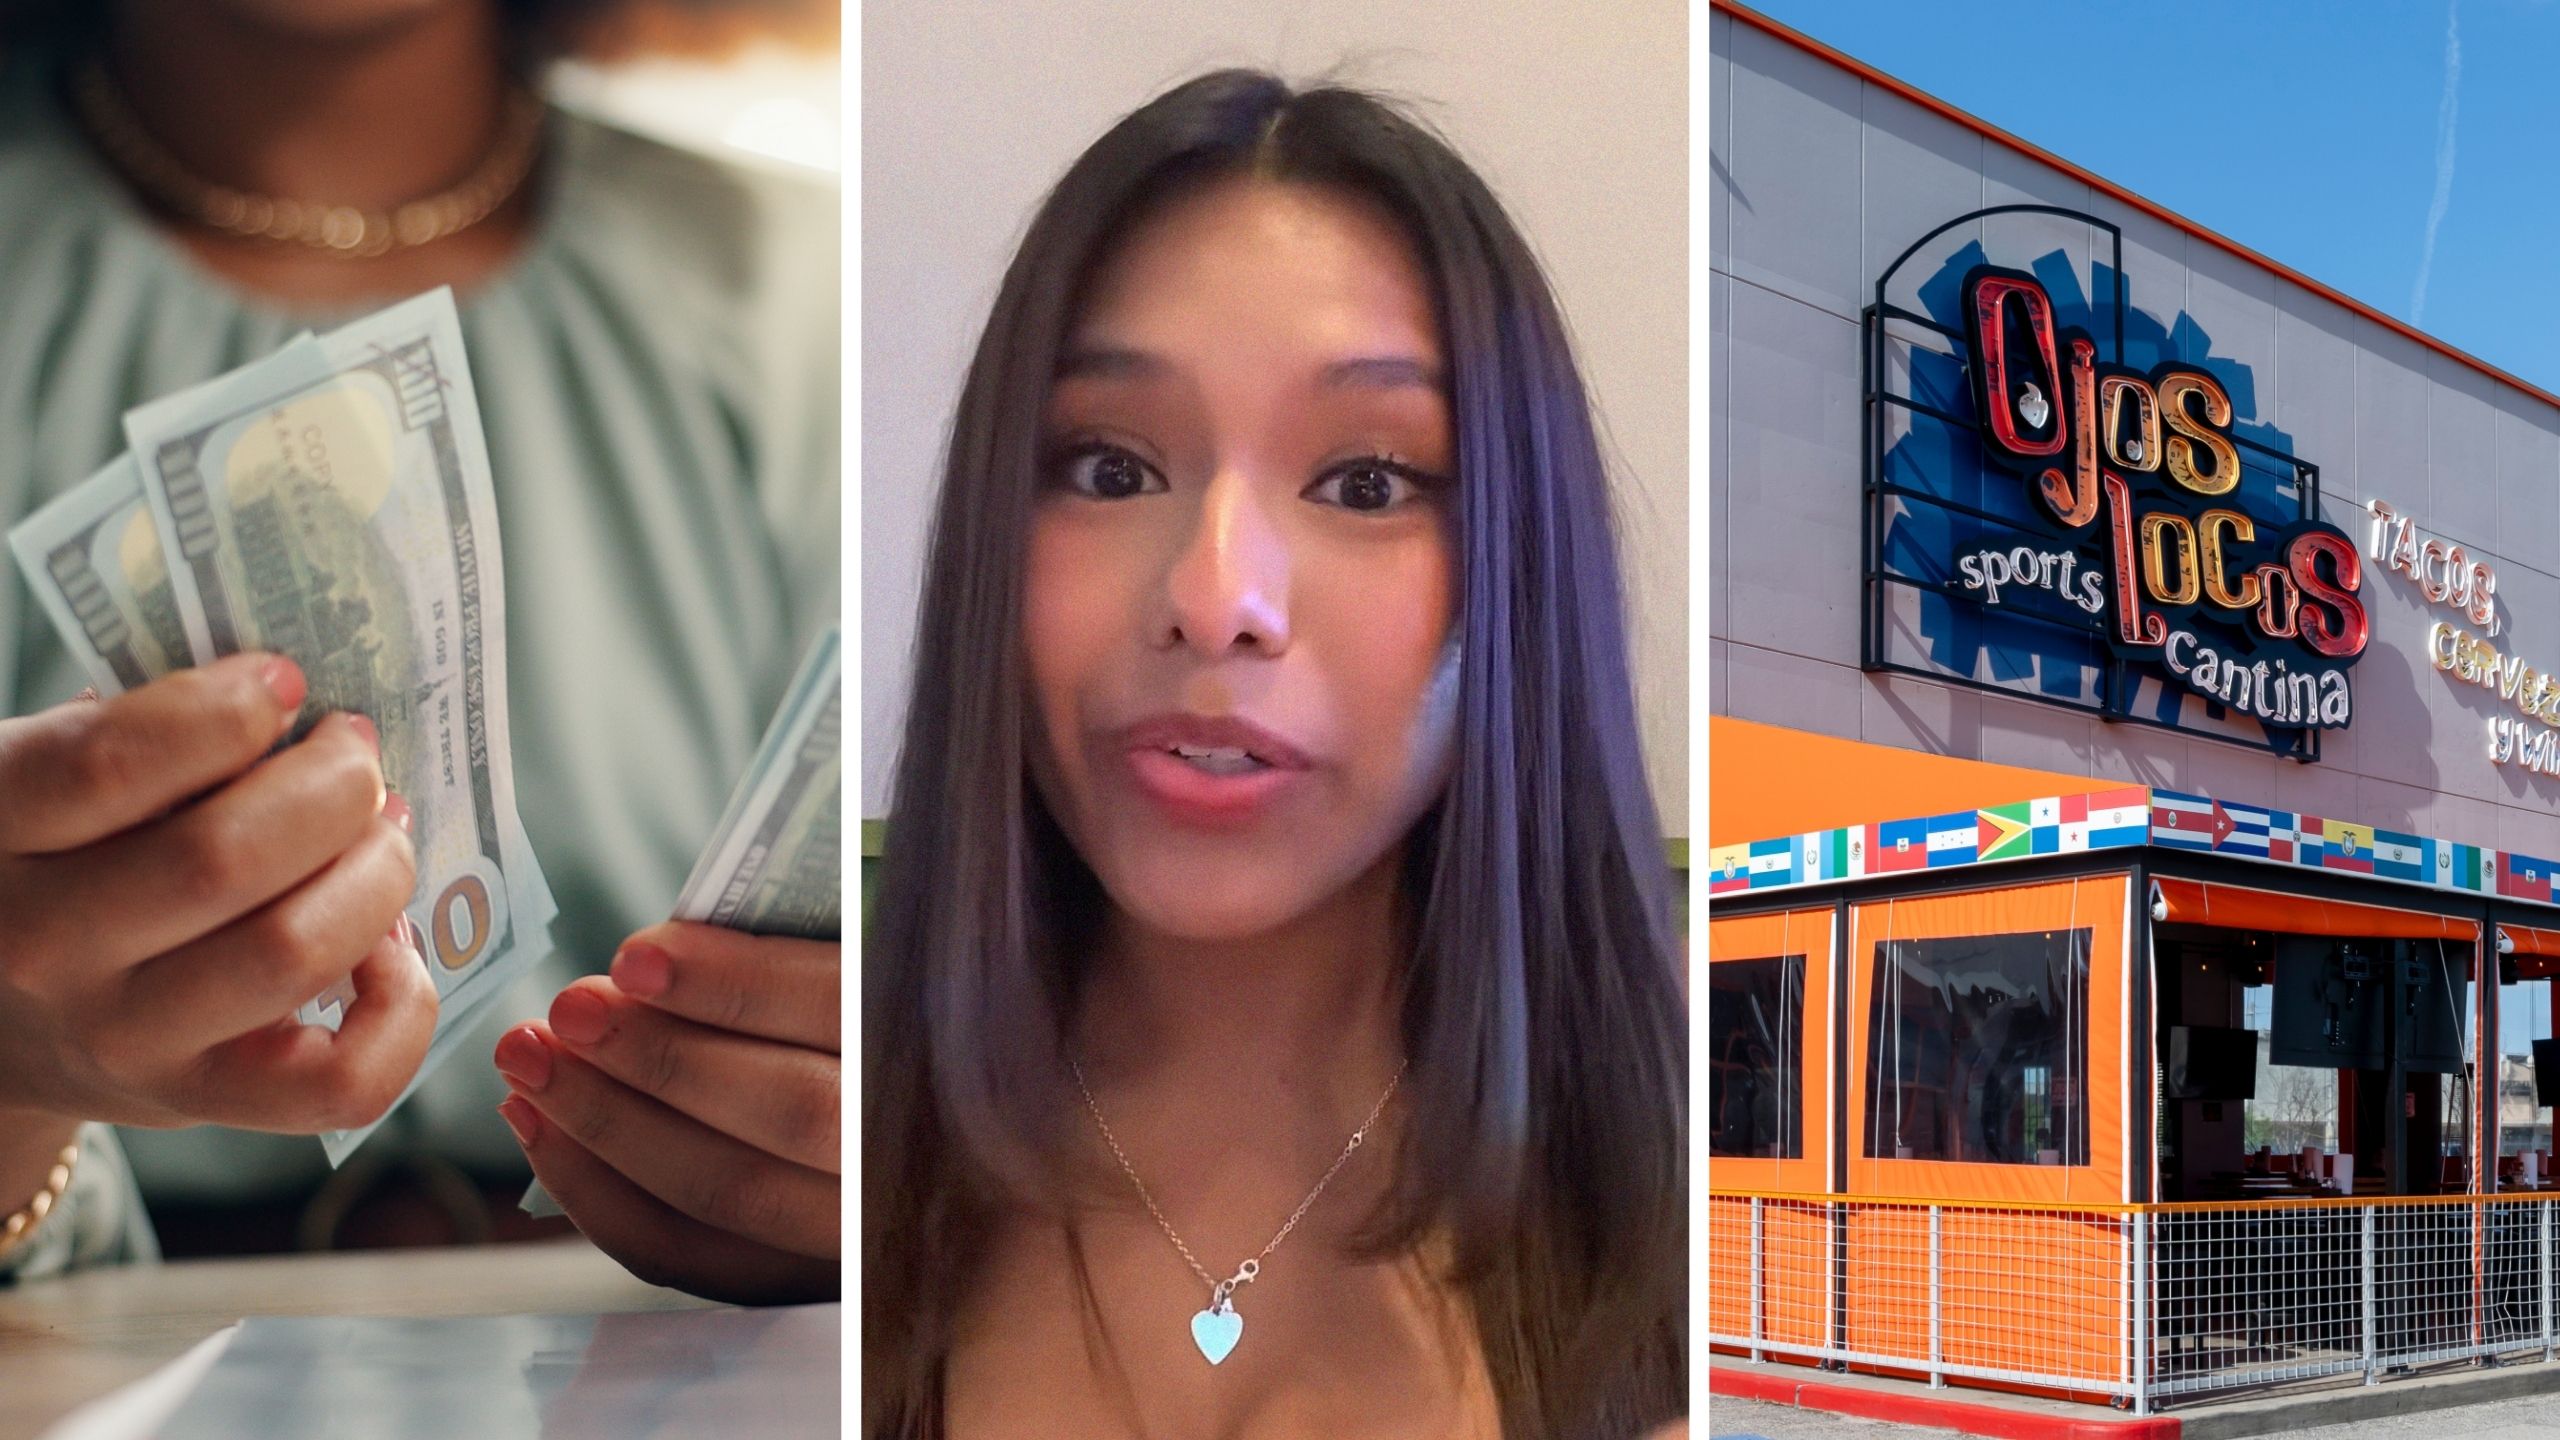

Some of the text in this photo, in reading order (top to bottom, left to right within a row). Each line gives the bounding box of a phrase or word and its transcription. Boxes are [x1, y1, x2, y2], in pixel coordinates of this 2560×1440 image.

[1960, 547, 2104, 613] sports
[435, 626, 448, 665] GOD
[2165, 631, 2351, 725] cantina
[440, 728, 456, 787] TRUST
